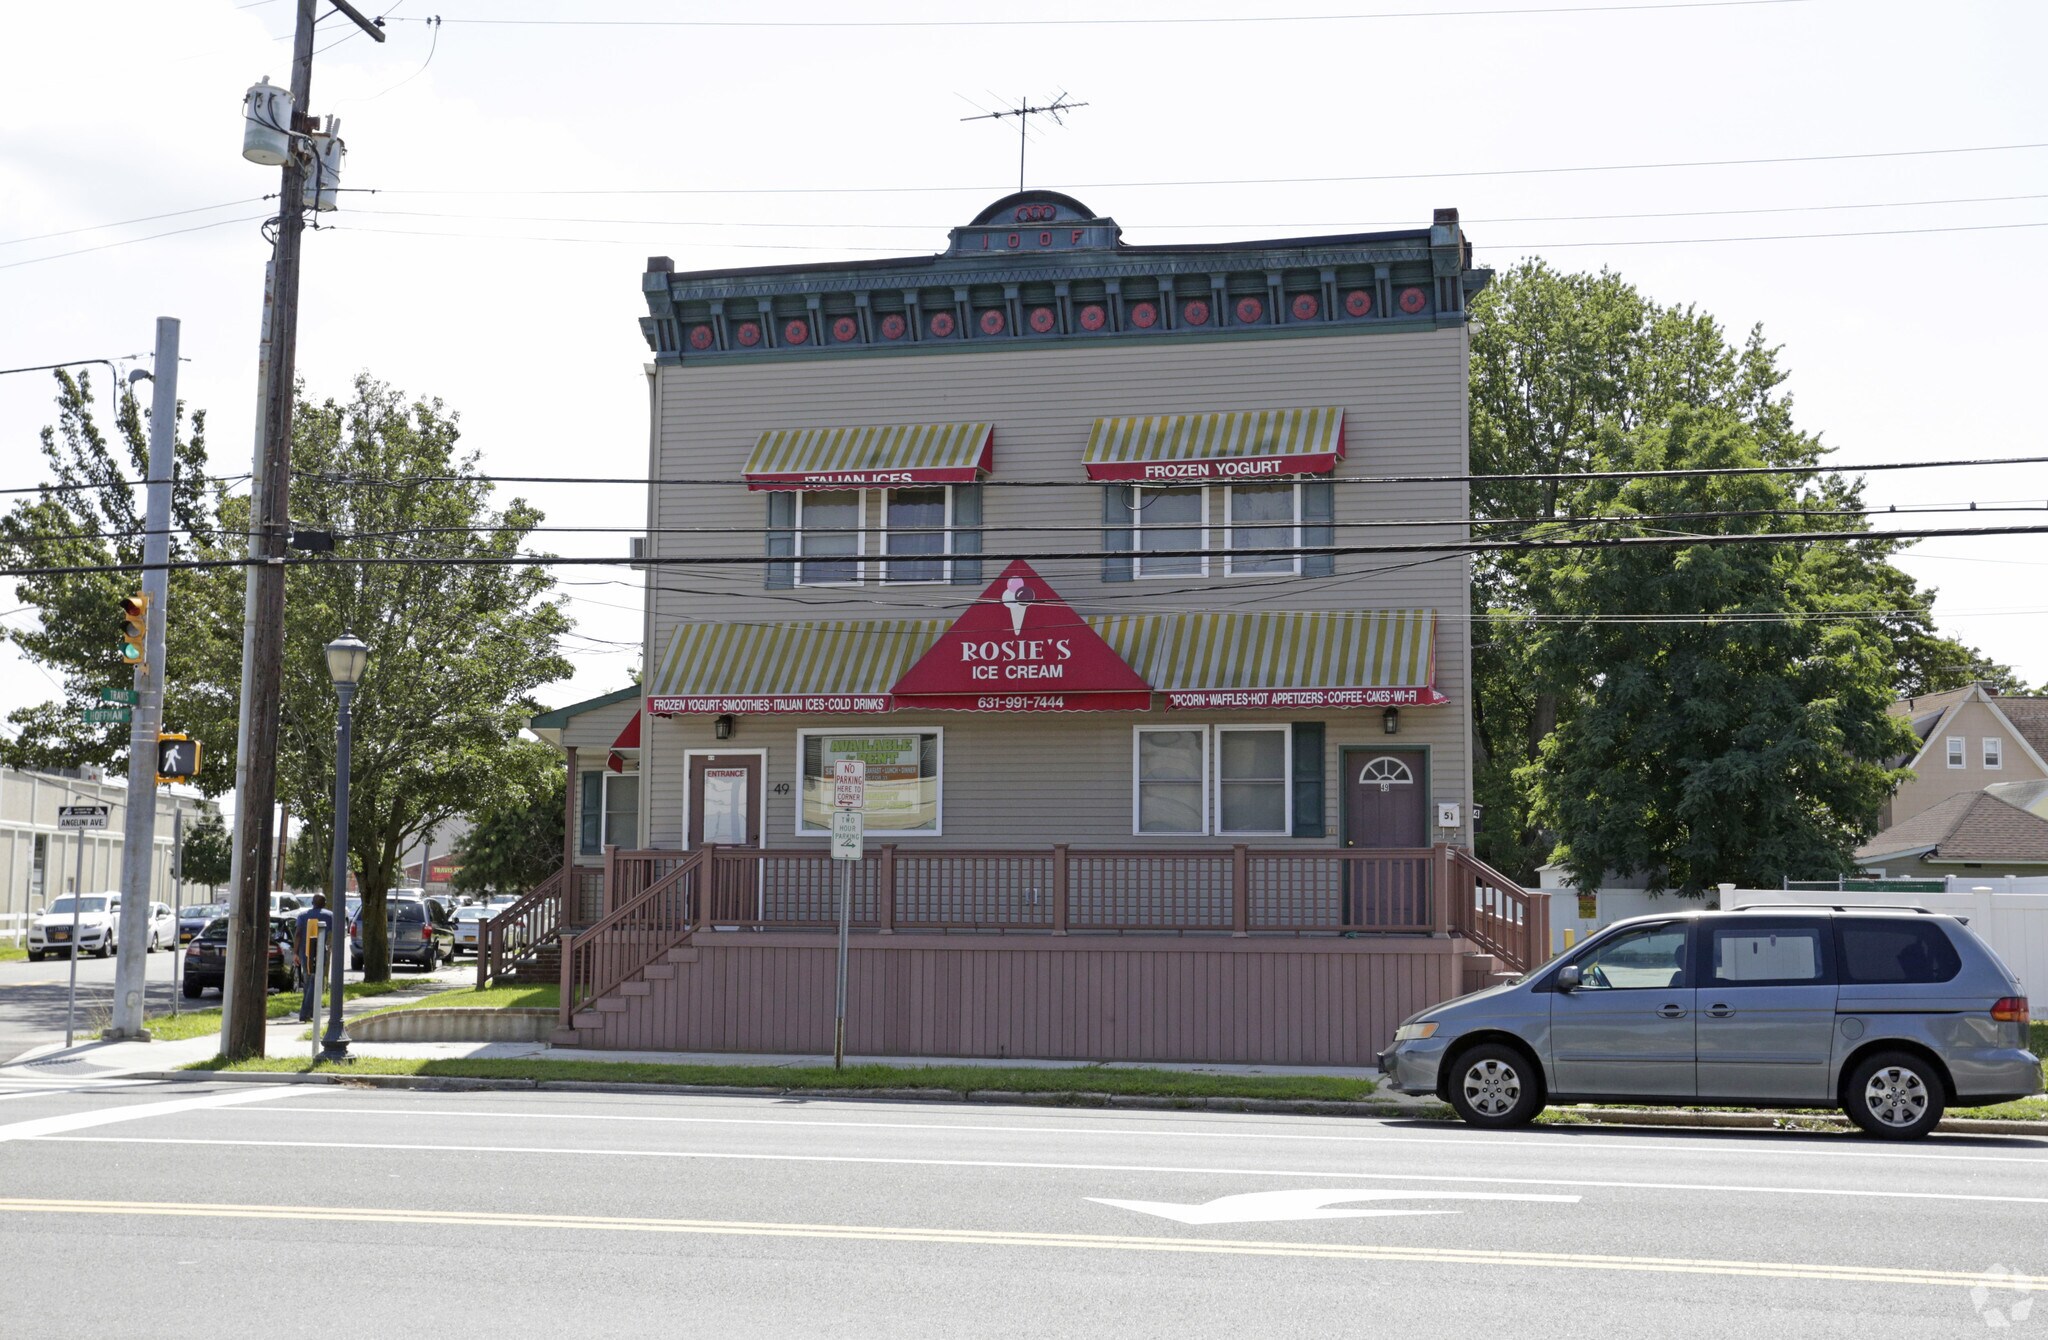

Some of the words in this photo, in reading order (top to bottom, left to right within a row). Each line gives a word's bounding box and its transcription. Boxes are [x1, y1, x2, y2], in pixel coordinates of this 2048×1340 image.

[1145, 463, 1210, 478] FROZEN
[1215, 460, 1282, 475] YOGURT
[804, 474, 865, 487] ITALIAN
[872, 472, 912, 484] ICES
[960, 638, 1072, 661] ROSIE'S
[972, 665, 999, 679] ICE
[1005, 664, 1063, 679] CREAM
[110, 690, 129, 702] TRAVIS
[977, 696, 1065, 708] 631-991-7444
[1209, 693, 1248, 706] WAFFLES
[1250, 692, 1269, 705] HOT
[1271, 691, 1324, 704] APPETIZERS
[1327, 691, 1363, 703] COFFEE
[1366, 690, 1391, 702] CAKES
[1393, 690, 1417, 702] WI-FI
[653, 699, 686, 711] FROZEN
[687, 699, 720, 711] YOGURT
[721, 699, 770, 711] SMOOTHIES
[773, 698, 803, 711] ITALIAN
[805, 698, 825, 710] ICES
[828, 698, 851, 710] COLD
[853, 698, 884, 710] DRINKS
[89, 710, 123, 721] HOFFMAN
[831, 739, 912, 752] AVAILABLE
[857, 752, 898, 764] RENT
[707, 770, 745, 778] ENTRANCE
[844, 765, 855, 774] NO
[836, 776, 862, 785] PARKING
[773, 783, 790, 796] 49
[61, 818, 89, 827] ANGELINI
